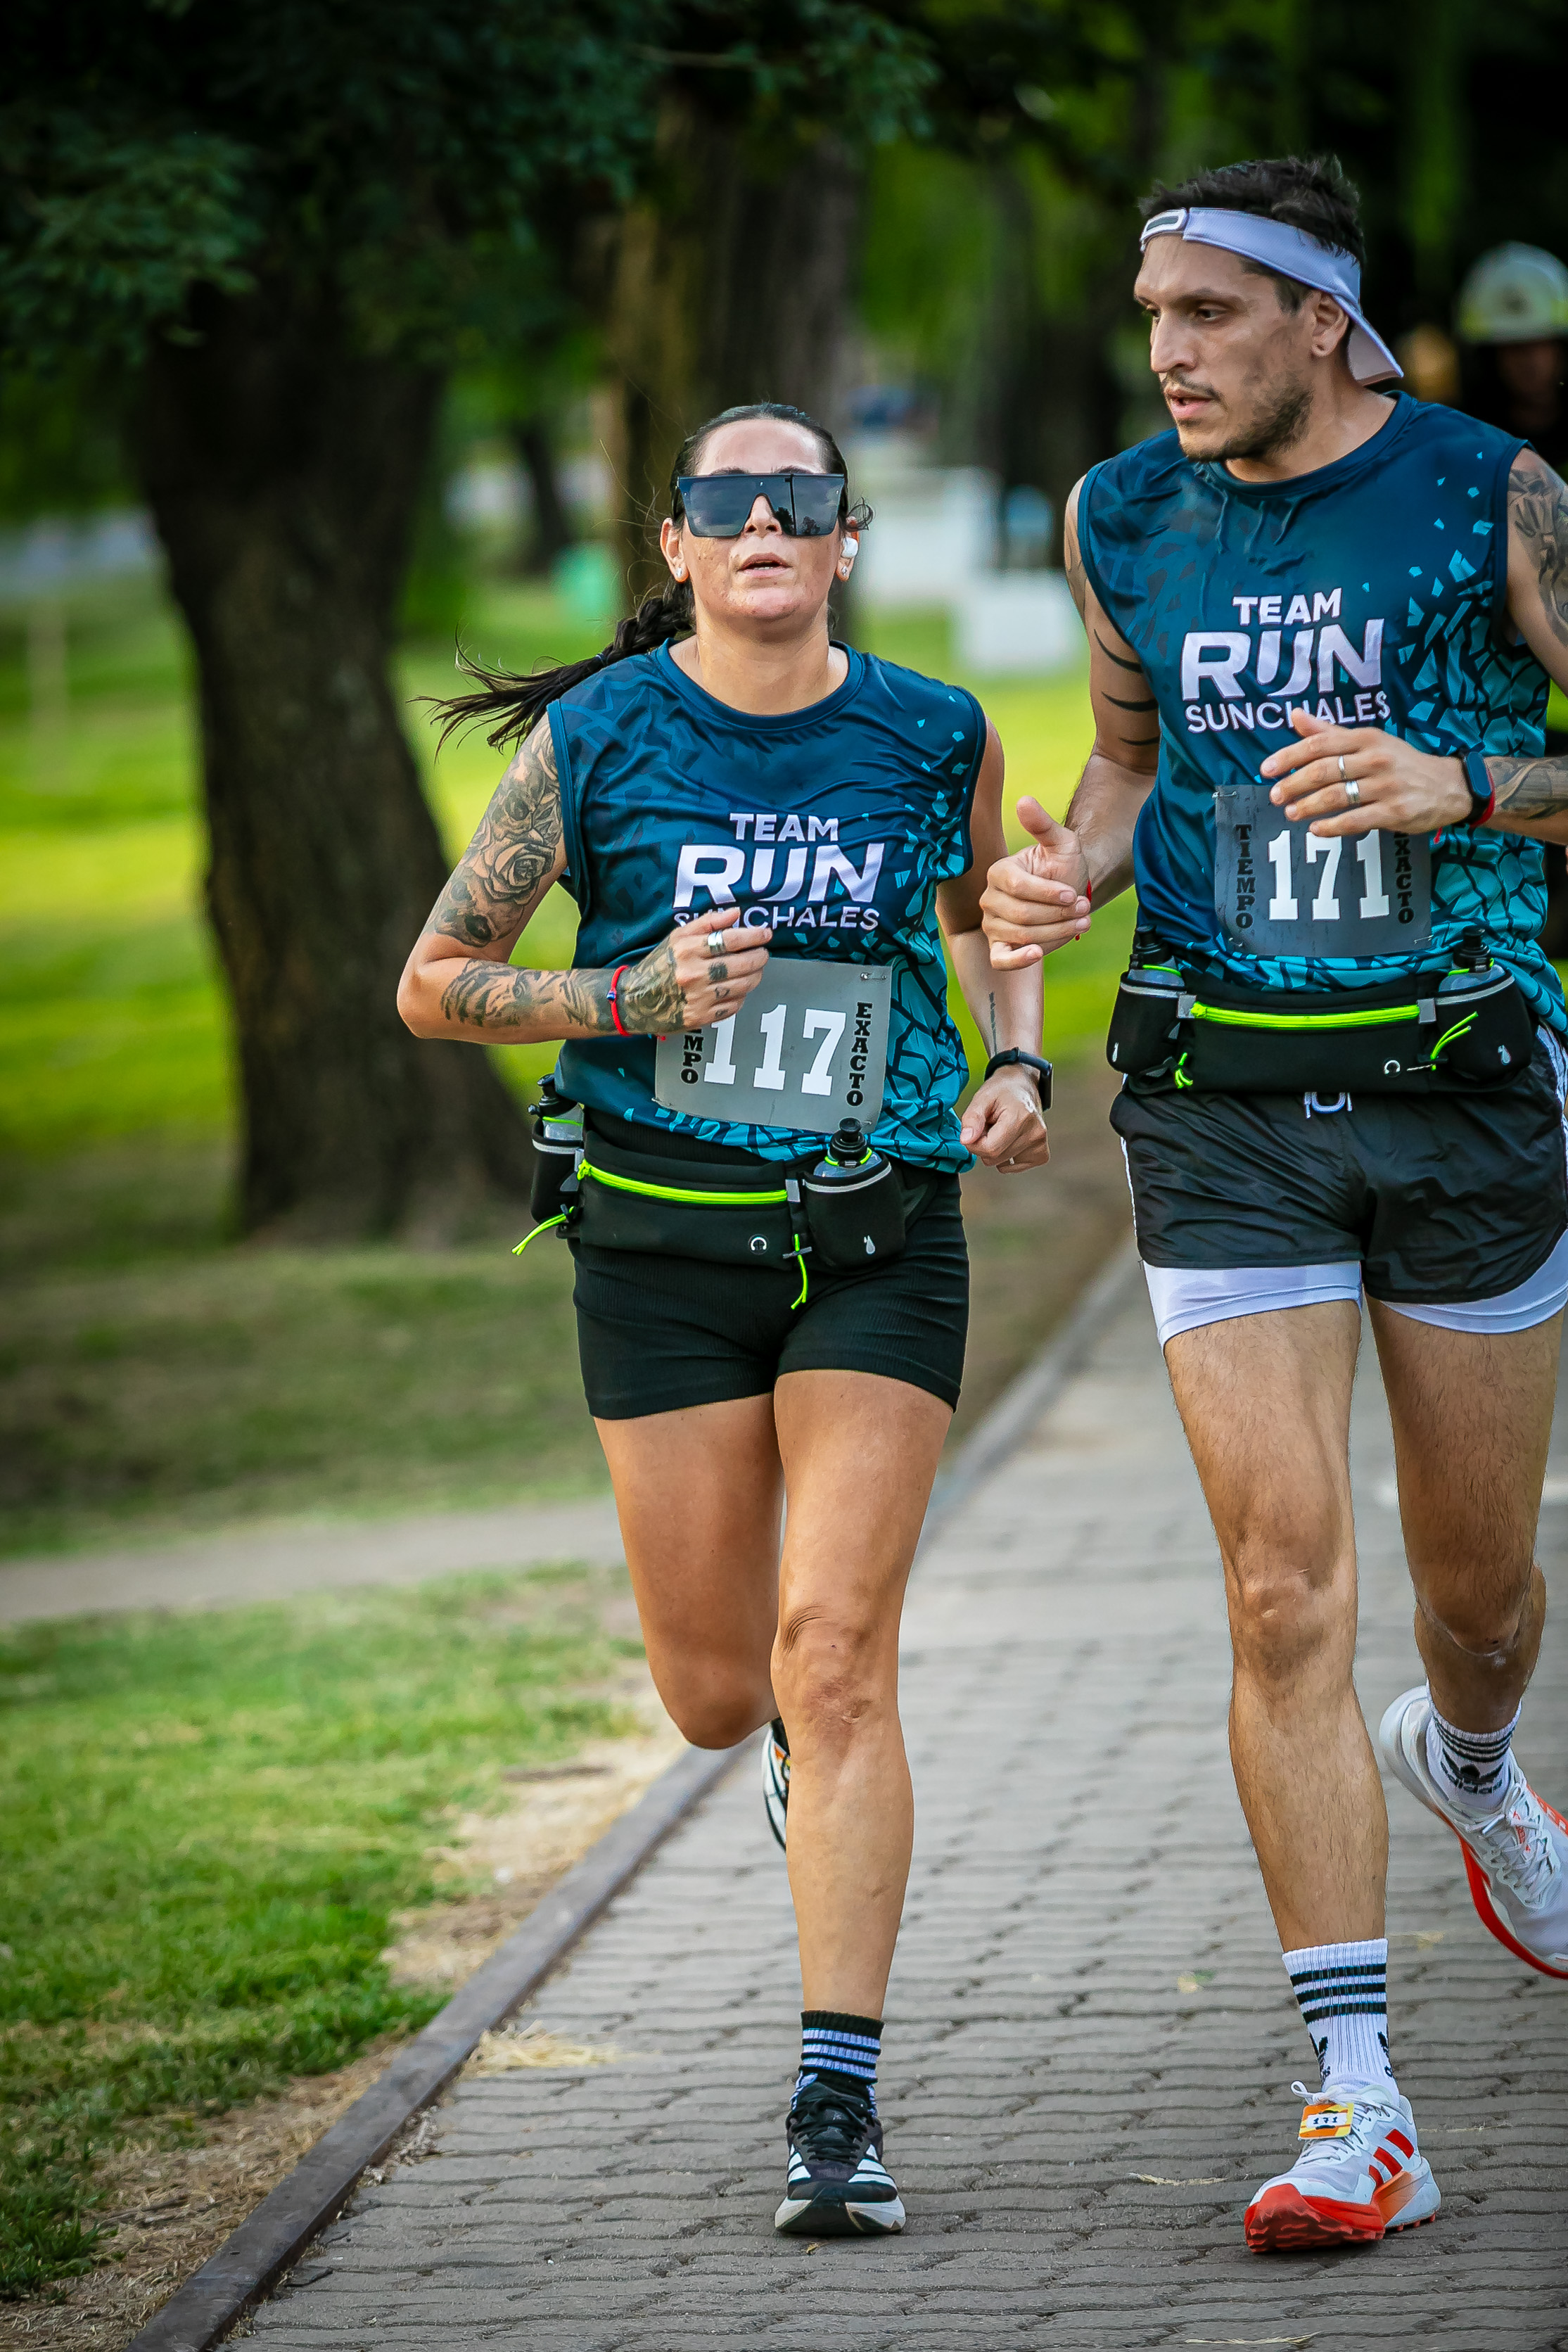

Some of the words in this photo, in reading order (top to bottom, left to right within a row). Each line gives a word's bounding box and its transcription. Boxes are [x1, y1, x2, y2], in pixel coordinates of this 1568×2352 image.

[1232, 587, 1342, 625] TEAM
[1181, 618, 1384, 701] RUN
[729, 813, 839, 841] TEAM
[673, 842, 885, 908] RUN
[1235, 824, 1256, 929] TIEMPO
[1268, 829, 1390, 921] 171
[673, 905, 880, 932] SCHALES
[703, 1003, 846, 1097] 117
[846, 1001, 873, 1107] EXACTO
[1440, 1761, 1503, 1795] adidas
[1313, 2116, 1338, 2125] 171
